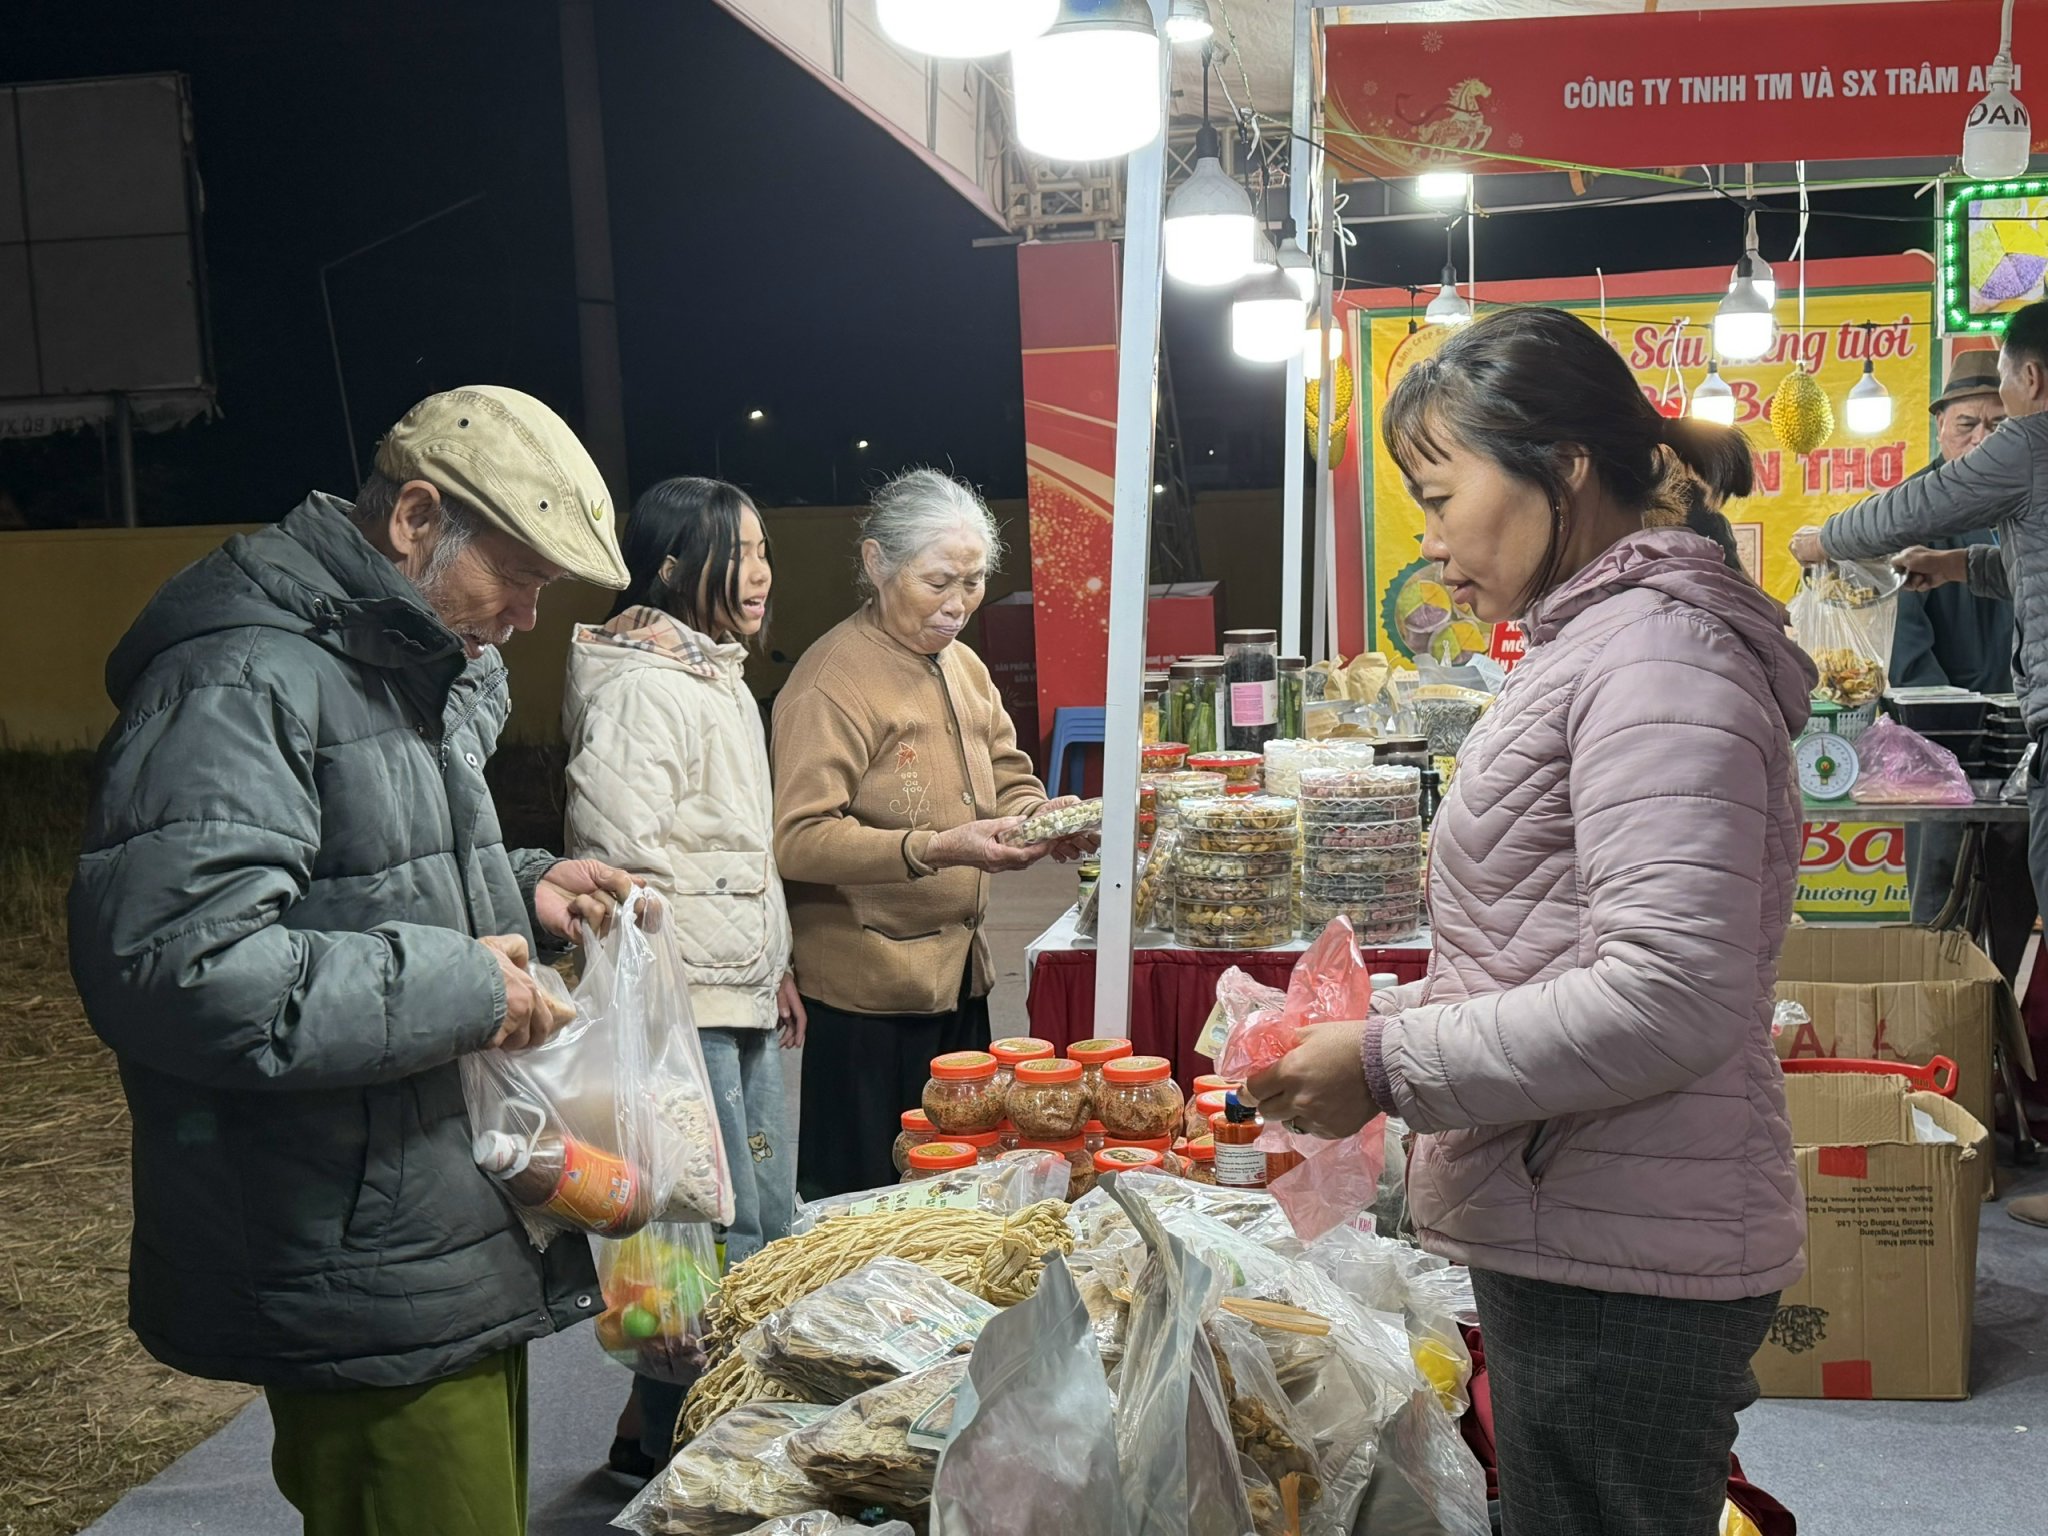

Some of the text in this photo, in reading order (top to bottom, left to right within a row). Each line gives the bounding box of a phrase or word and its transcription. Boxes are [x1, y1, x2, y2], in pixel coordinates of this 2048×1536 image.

[1564, 61, 2022, 109] CÔNG TY TNHH TM VÀ SX TRÂM AH
[1799, 441, 1905, 491] THƠ
[1795, 885, 1878, 906] hương
[1835, 1220, 1851, 1228] Ltd.
